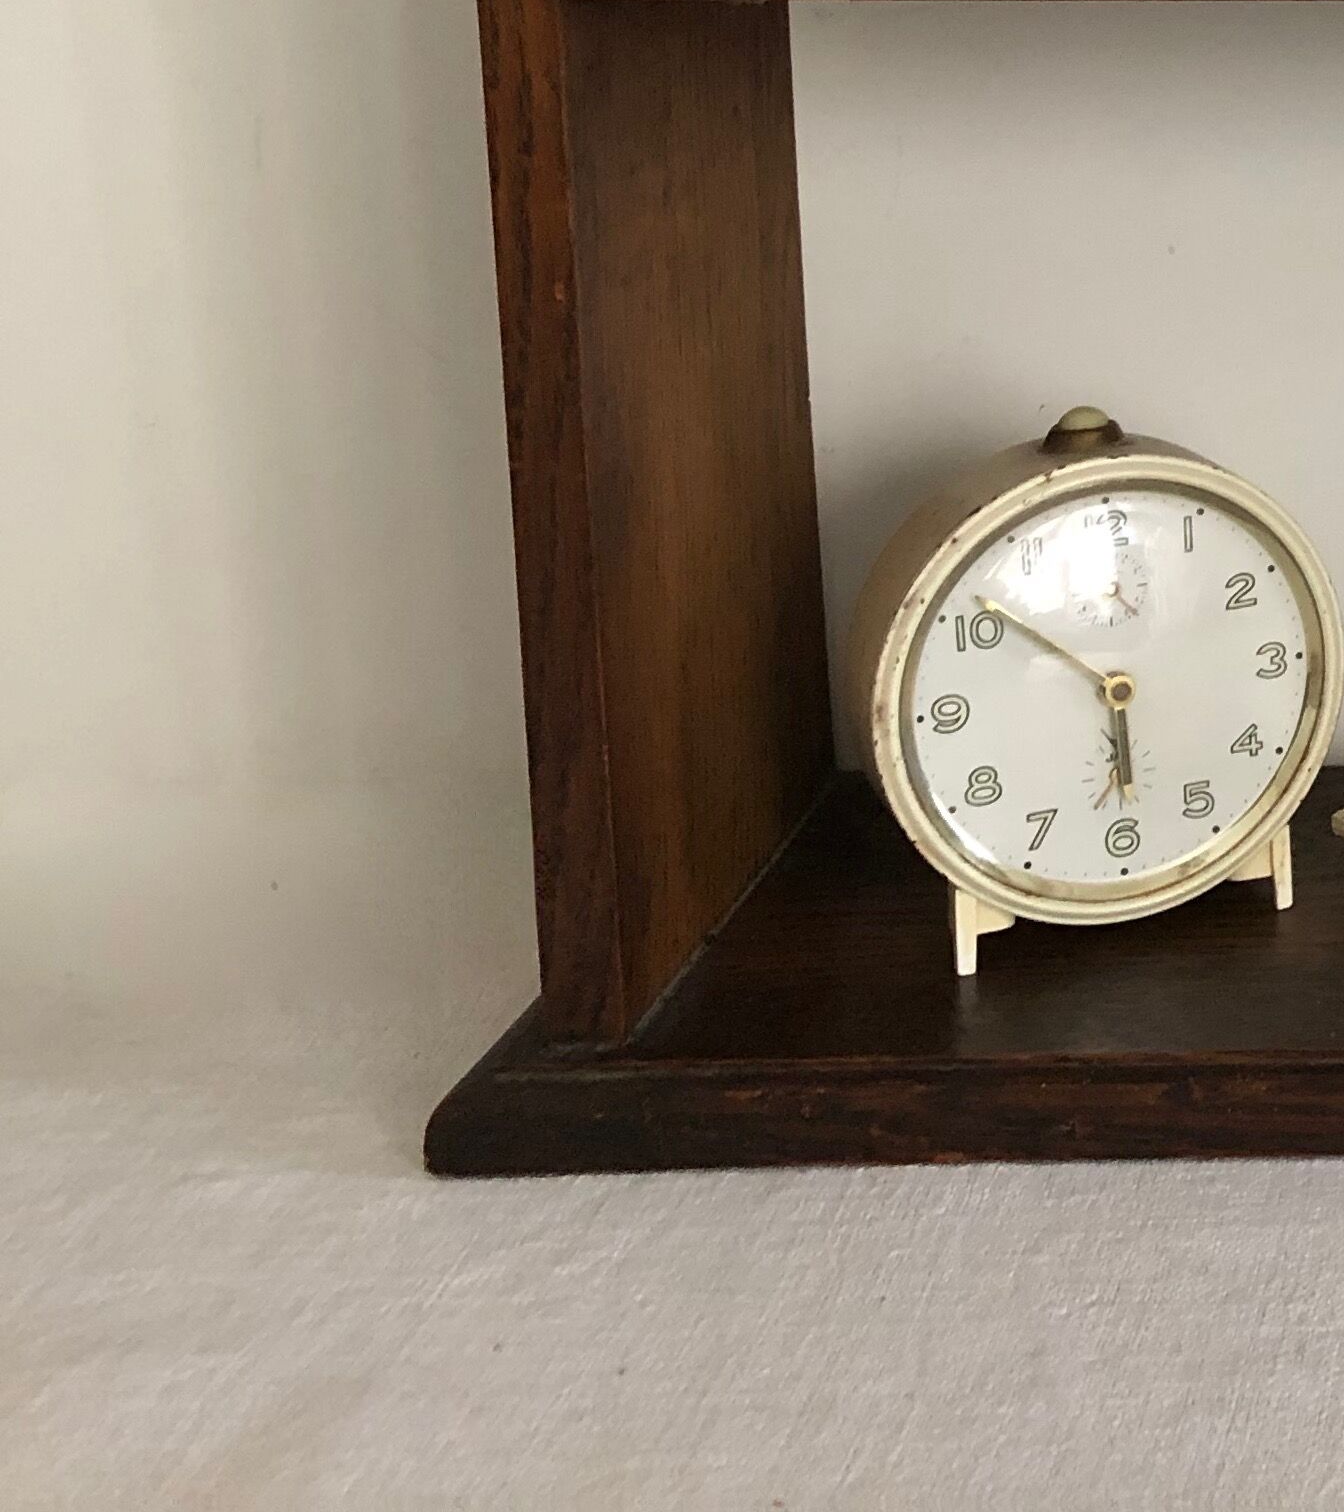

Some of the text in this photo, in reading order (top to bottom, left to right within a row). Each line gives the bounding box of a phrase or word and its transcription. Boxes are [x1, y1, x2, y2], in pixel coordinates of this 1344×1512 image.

[1182, 516, 1194, 553] 1
[1225, 572, 1258, 610] 2
[955, 610, 1005, 653] 10
[1255, 642, 1288, 679] 3
[930, 693, 971, 734] 9
[1230, 724, 1264, 758] 4
[963, 765, 1003, 808] 8
[1182, 780, 1215, 819] 5
[1026, 809, 1058, 852] 7
[1104, 818, 1141, 858] 6
